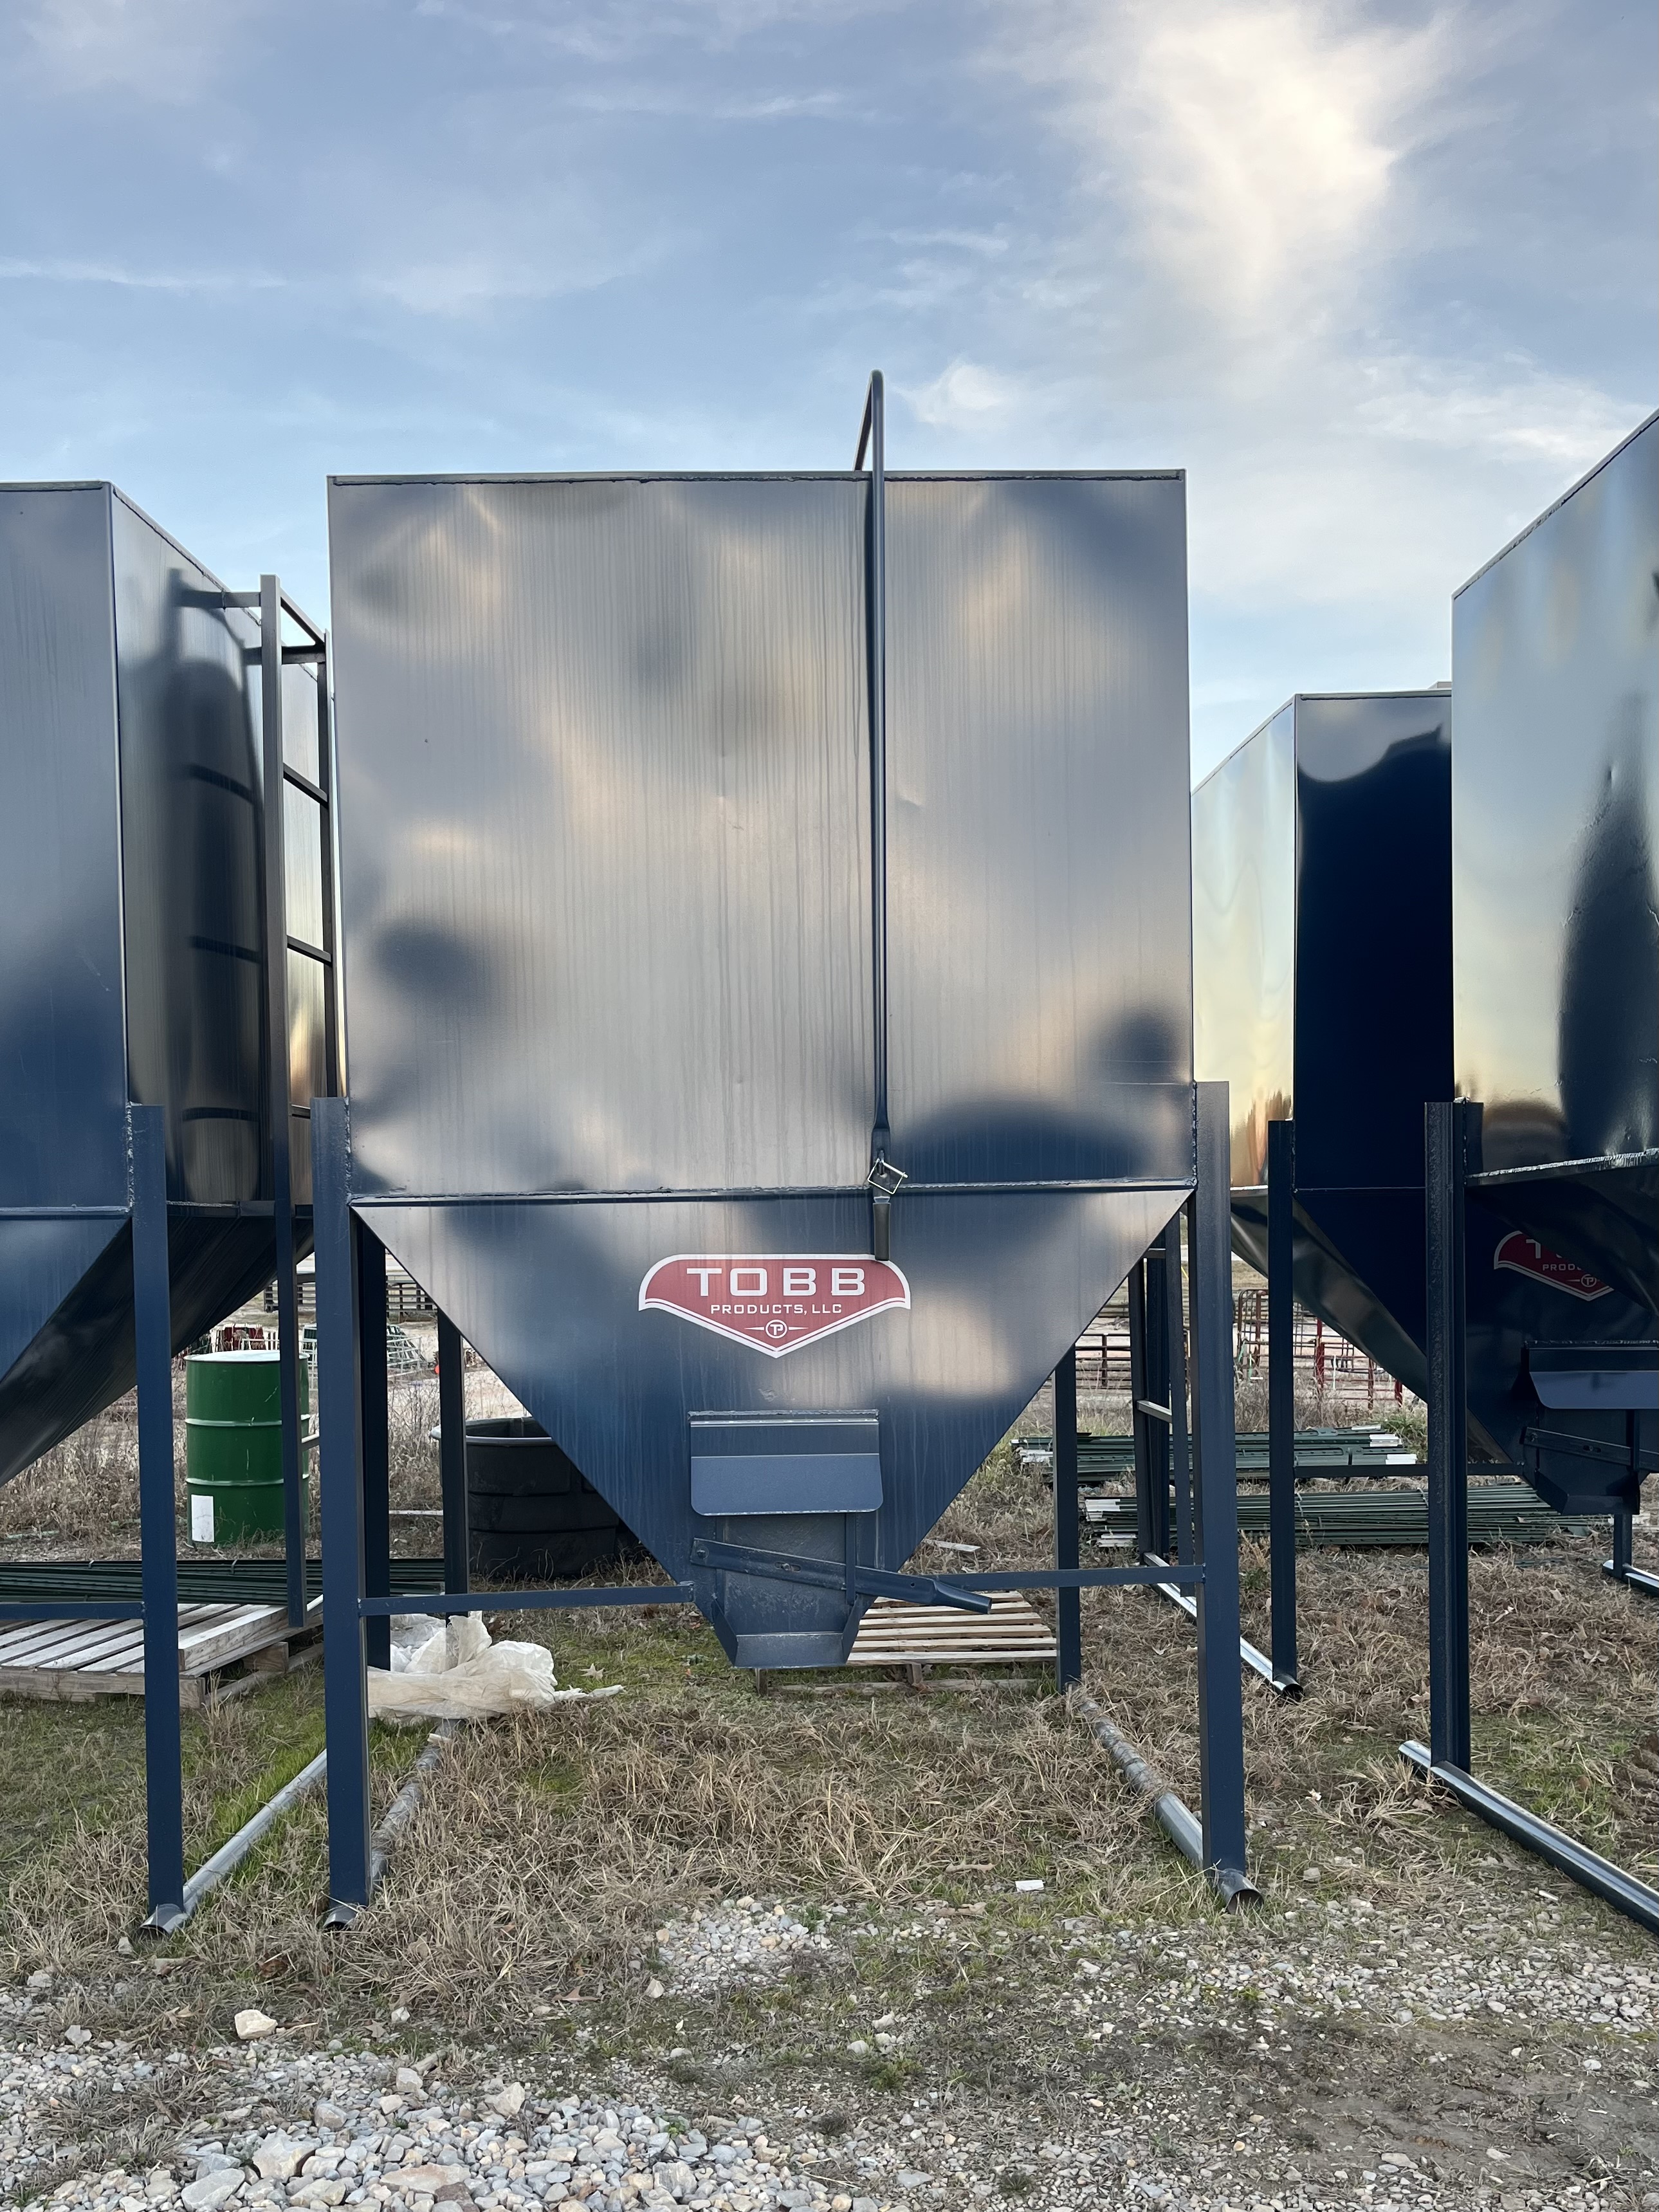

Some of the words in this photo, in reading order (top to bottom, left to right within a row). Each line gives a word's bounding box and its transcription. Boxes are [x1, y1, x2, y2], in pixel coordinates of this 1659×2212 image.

[686, 1267, 865, 1296] TOBB
[710, 1304, 807, 1316] PRODUCTS,
[812, 1304, 842, 1314] LLC
